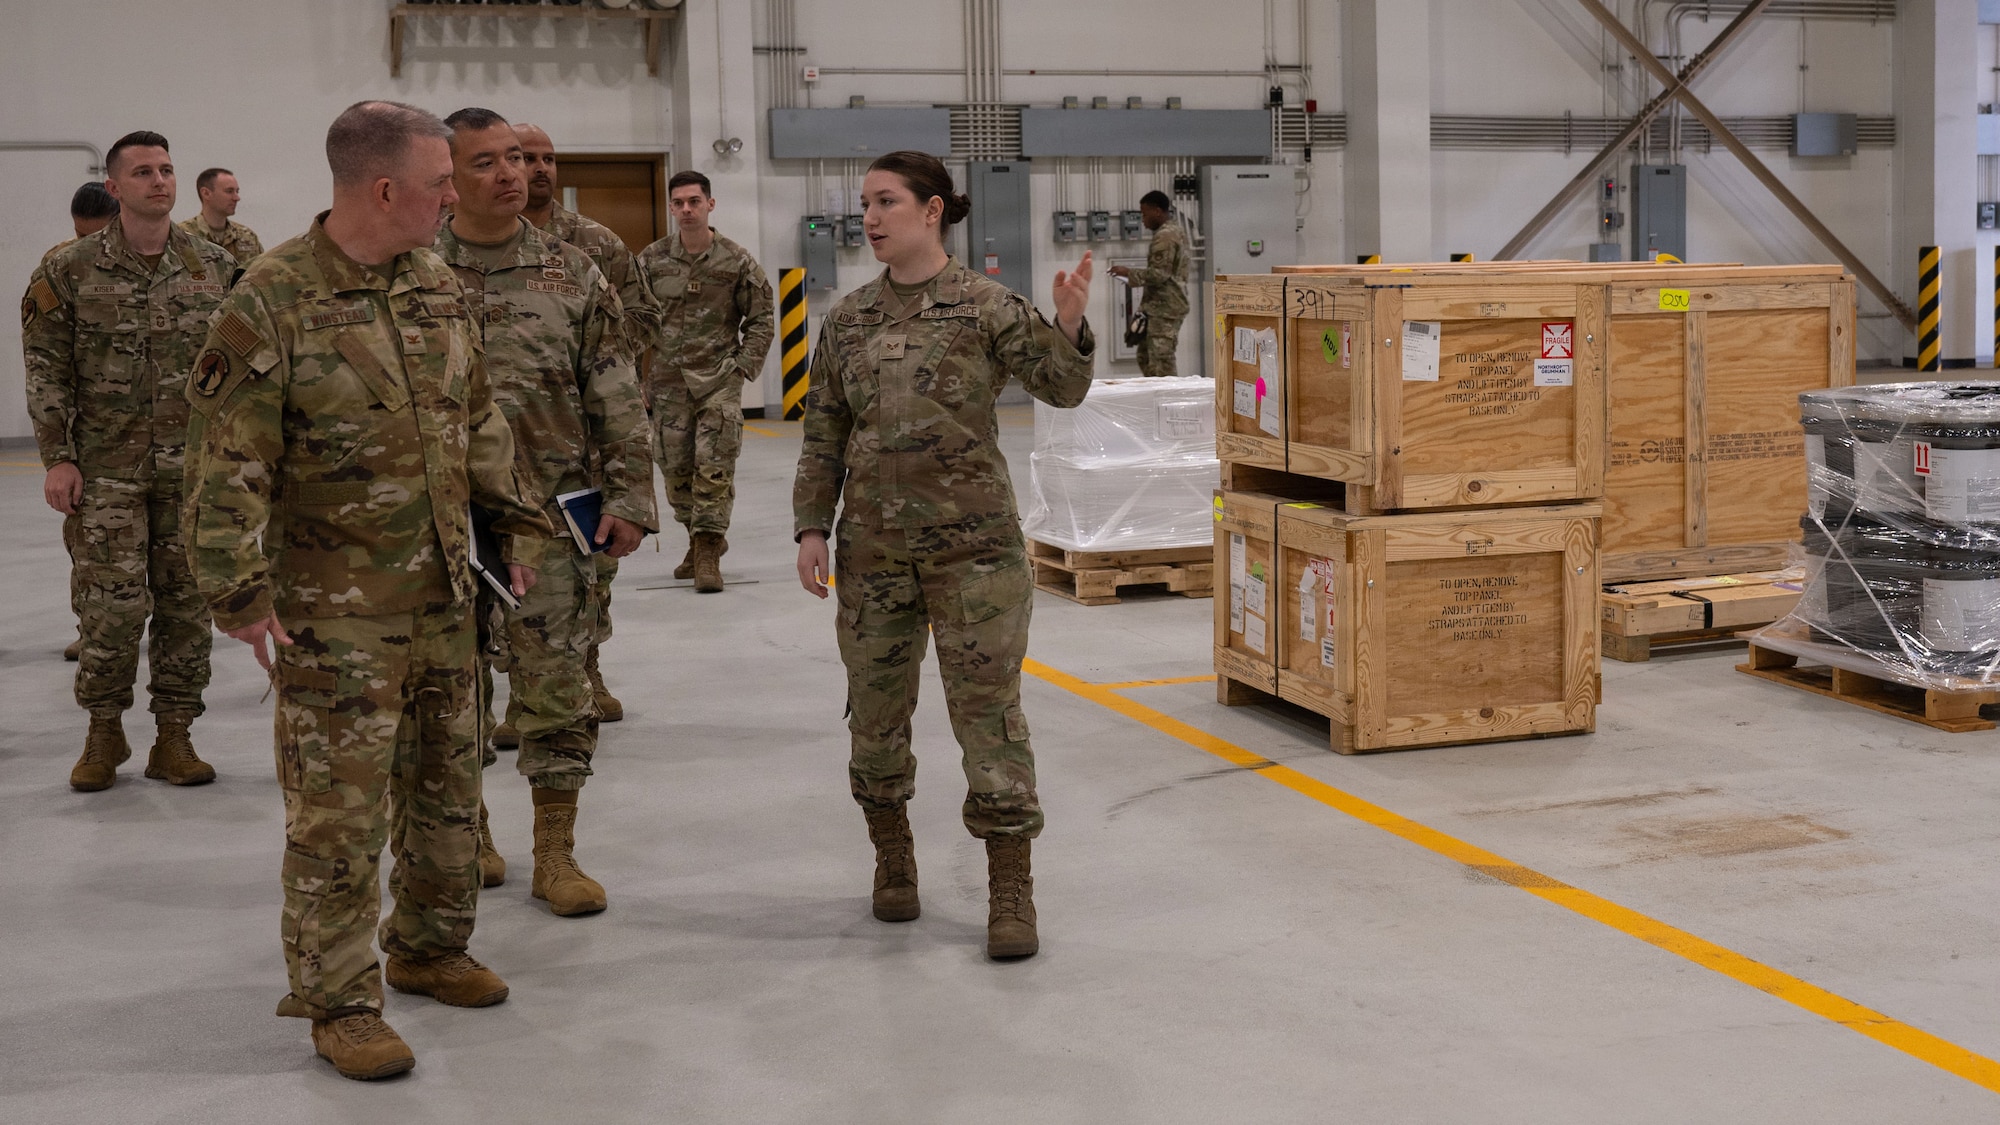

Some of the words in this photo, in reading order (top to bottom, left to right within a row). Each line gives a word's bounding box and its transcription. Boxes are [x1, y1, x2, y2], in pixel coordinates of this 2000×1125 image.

[528, 281, 539, 290] U.S.
[542, 282, 555, 291] AIR
[556, 284, 580, 296] FORCE
[310, 309, 367, 327] WINSTEAD
[923, 308, 938, 318] U.S.
[940, 308, 950, 317] AIR
[951, 306, 977, 316] FORCE
[1455, 354, 1466, 363] TO
[1470, 353, 1496, 363] OPEN,
[1498, 352, 1531, 362] REMOVE
[1470, 366, 1486, 376] TOP
[1487, 366, 1516, 376] PANEL
[1458, 380, 1474, 390] AND
[1476, 379, 1495, 389] LIFT
[1496, 379, 1516, 388] ITEM
[1516, 378, 1528, 388] BY
[1445, 393, 1480, 403] STRAPS
[1482, 391, 1527, 403] ATTACHED
[1529, 391, 1540, 400] TO
[1470, 406, 1492, 416] BASE
[1494, 405, 1516, 415] ONLY
[1440, 579, 1451, 589] TO
[1454, 578, 1481, 589] OPEN,
[1482, 576, 1518, 587] REMOVE
[1454, 592, 1471, 601] TOP
[1473, 590, 1502, 600] PANEL
[1442, 606, 1459, 616] AND
[1461, 604, 1480, 614] LIFT
[1482, 602, 1502, 613] ITEM
[1503, 602, 1515, 612] BY
[1428, 619, 1464, 630] STRAPS
[1466, 615, 1514, 628] ATTACHED
[1515, 615, 1526, 624] TO
[1454, 630, 1477, 641] BASE
[1479, 629, 1502, 639] ONLY
